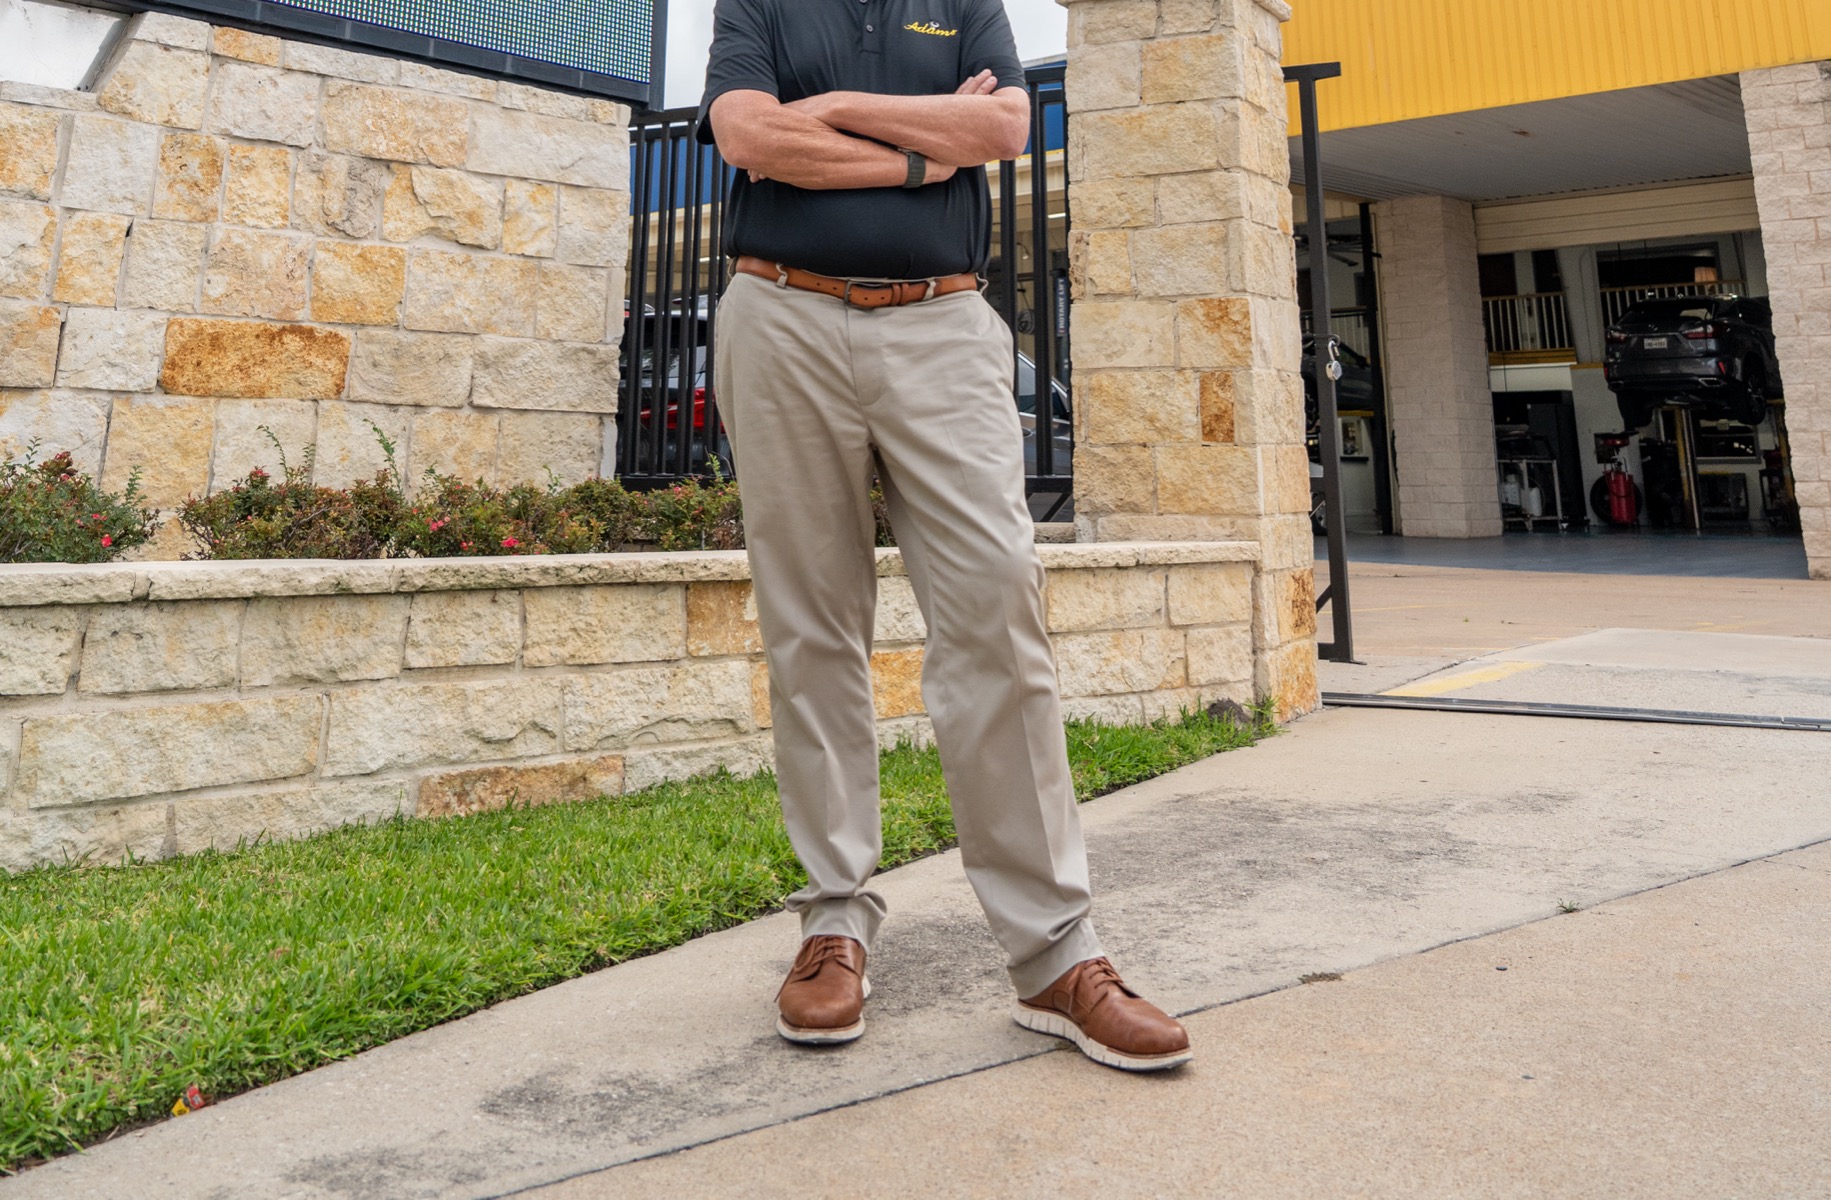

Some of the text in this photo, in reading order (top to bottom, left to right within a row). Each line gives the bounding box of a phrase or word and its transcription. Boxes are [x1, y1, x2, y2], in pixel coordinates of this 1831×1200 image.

[903, 21, 958, 37] Adams
[1058, 278, 1066, 329] ROTARY LIFT
